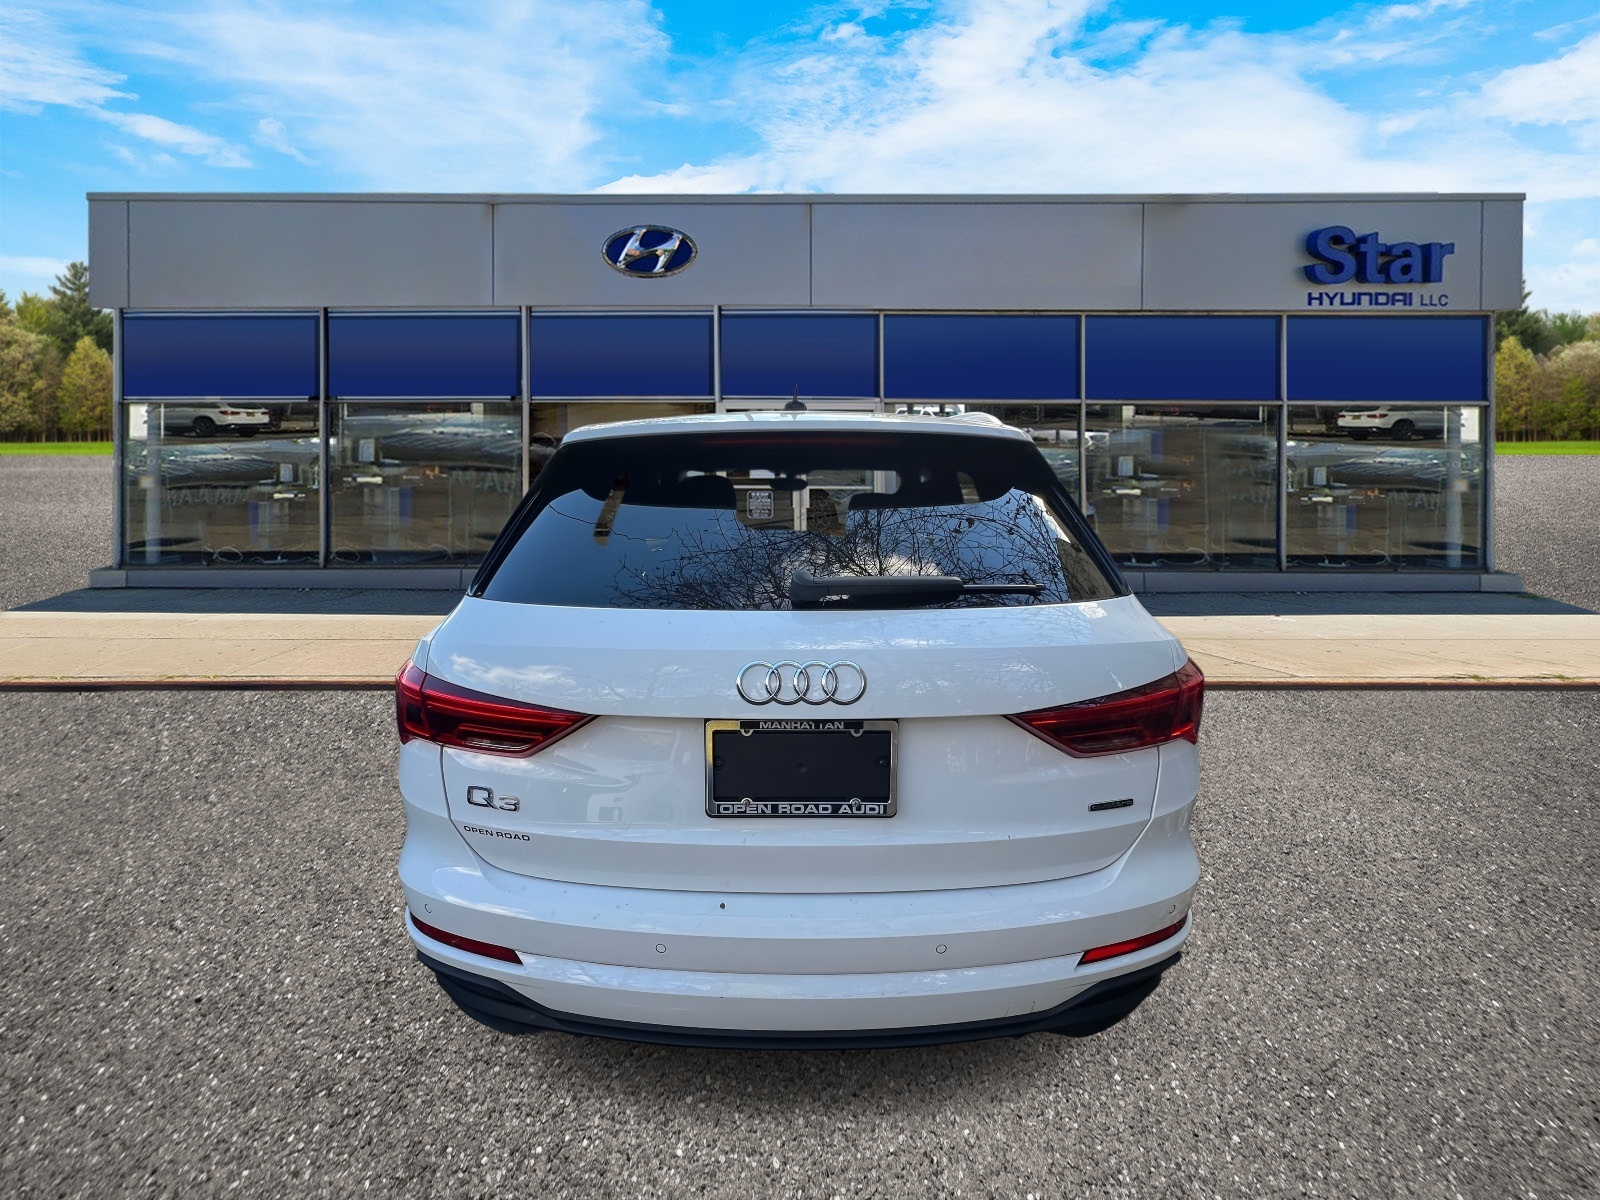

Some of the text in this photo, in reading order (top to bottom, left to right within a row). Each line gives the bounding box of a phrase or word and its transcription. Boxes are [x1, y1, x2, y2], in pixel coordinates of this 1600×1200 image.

[1303, 225, 1455, 284] Star
[1307, 292, 1449, 307] HYUNDAI LLC
[467, 785, 520, 813] Q3
[719, 804, 884, 815] OPEN ROAD AUDI
[463, 825, 531, 842] OPEN ROAD
